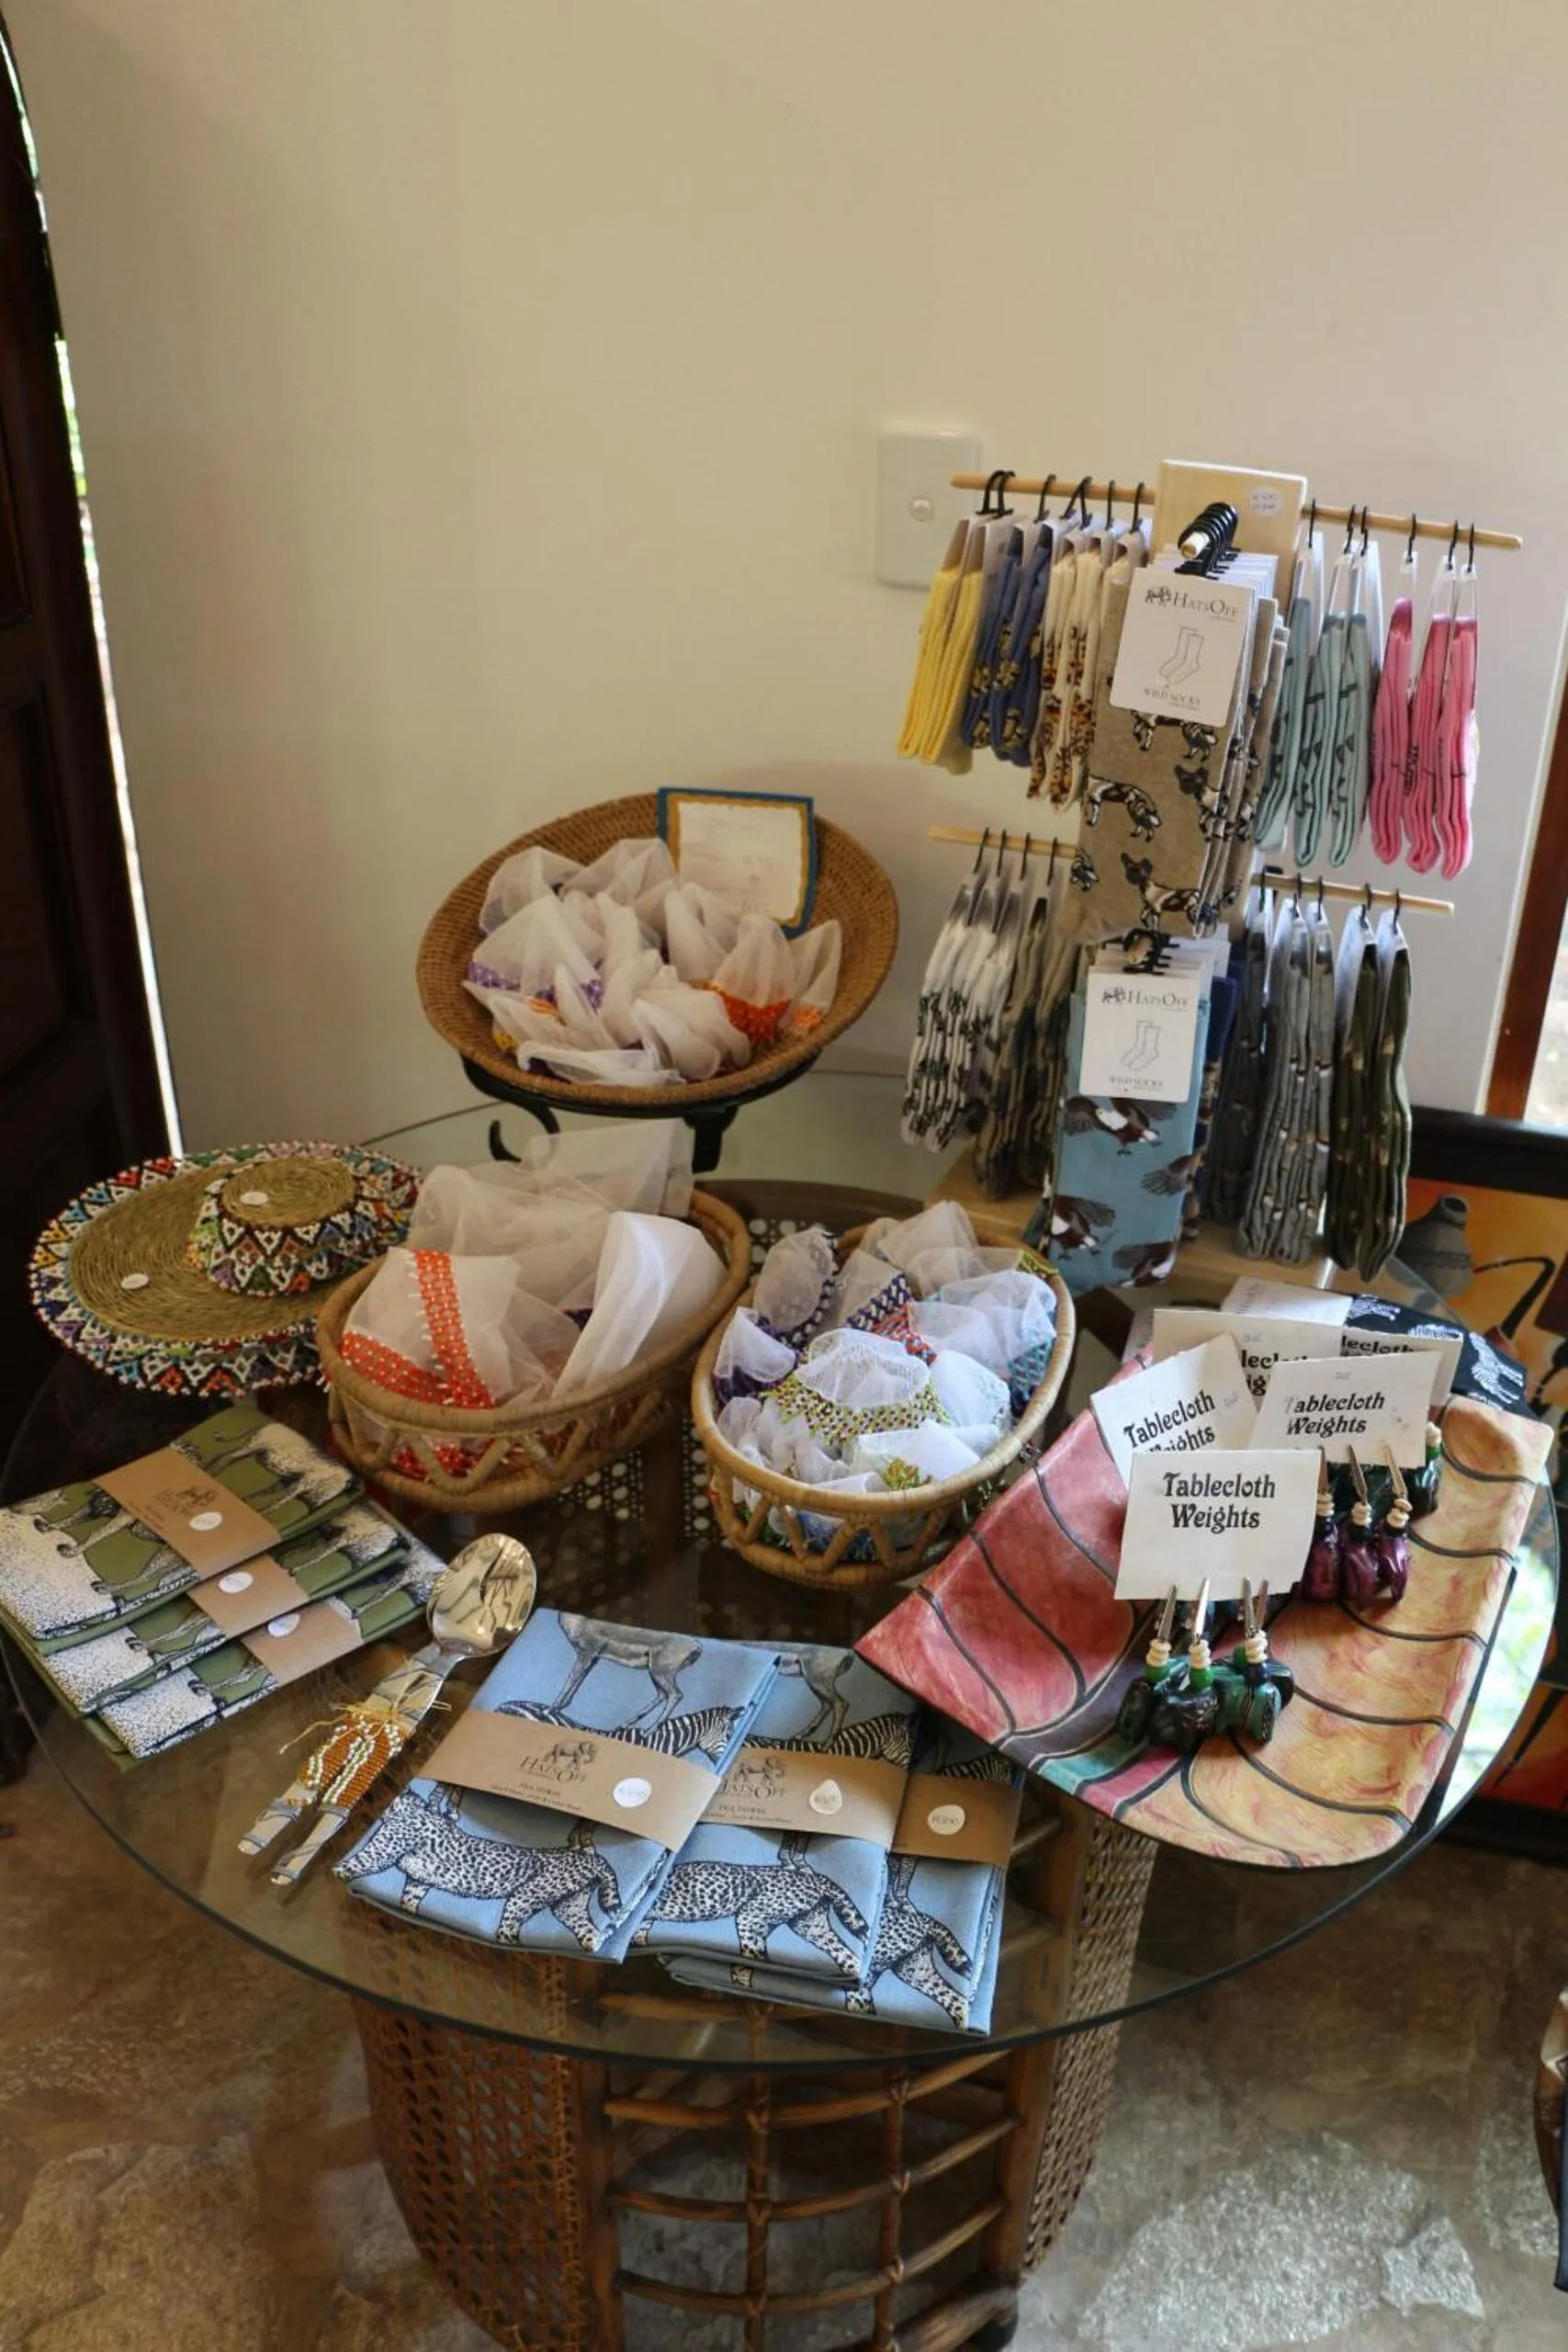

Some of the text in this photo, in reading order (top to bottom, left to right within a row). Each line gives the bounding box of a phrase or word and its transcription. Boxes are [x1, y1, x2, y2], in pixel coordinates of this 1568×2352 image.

[1123, 1389, 1215, 1448] Tablecloth
[1287, 1415, 1367, 1438] Weights
[1145, 1426, 1215, 1452] ights
[1163, 1472, 1276, 1498] Tablecloth
[1171, 1503, 1260, 1534] Weights
